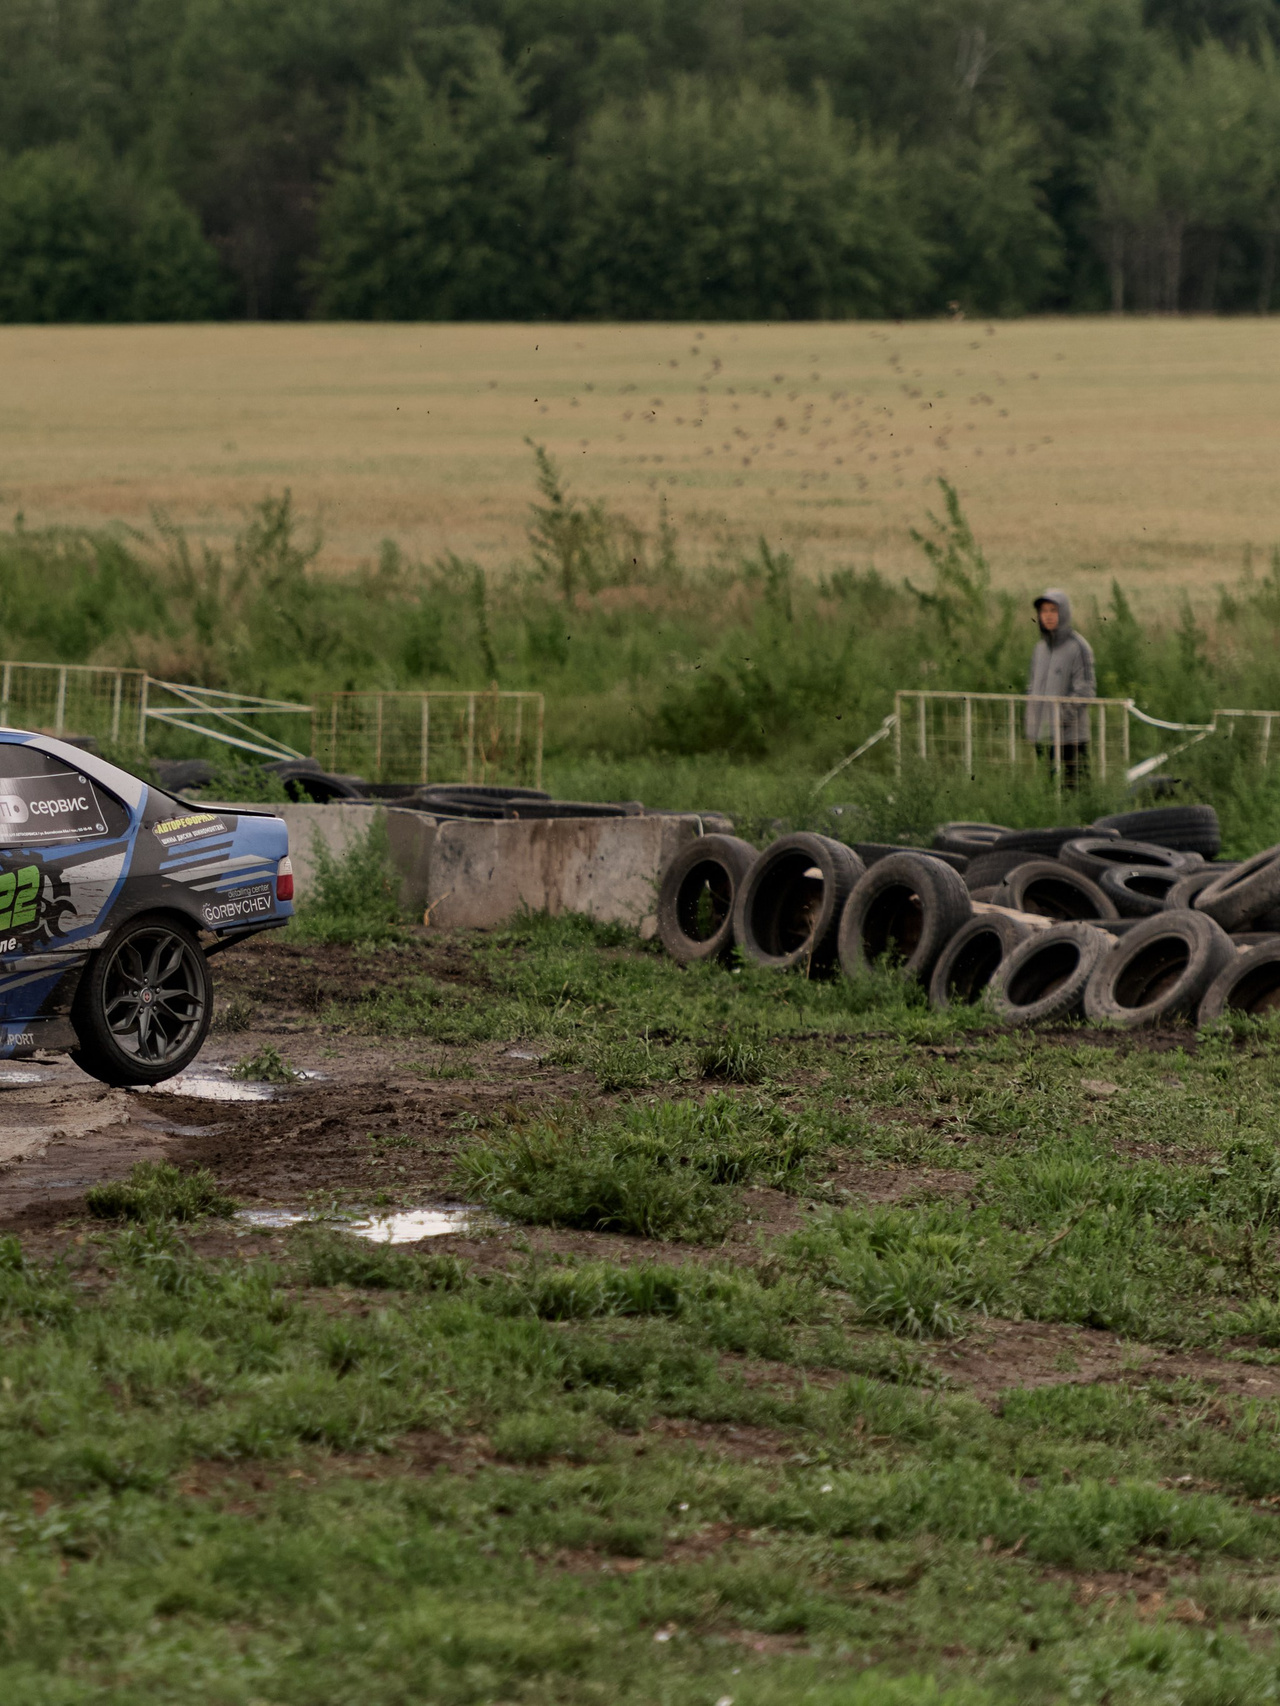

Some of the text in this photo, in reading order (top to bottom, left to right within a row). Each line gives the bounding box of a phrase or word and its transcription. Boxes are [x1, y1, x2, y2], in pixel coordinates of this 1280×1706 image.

[29, 796, 90, 817] сервис
[228, 884, 270, 897] detailing center
